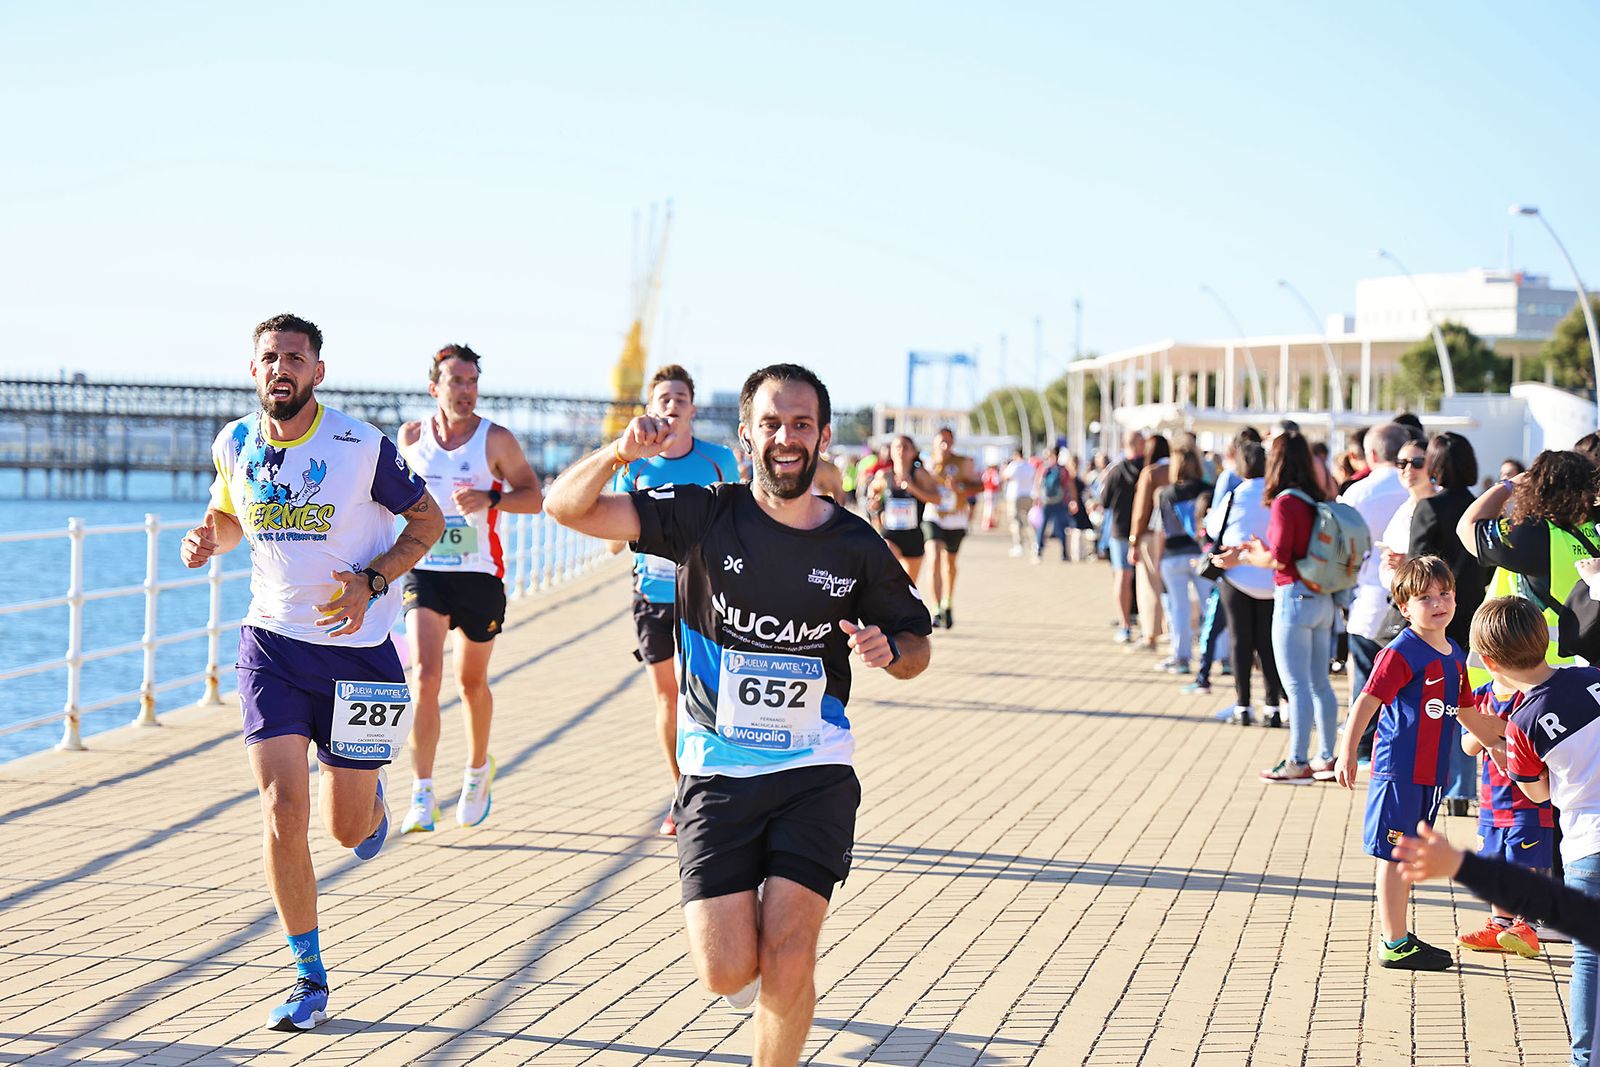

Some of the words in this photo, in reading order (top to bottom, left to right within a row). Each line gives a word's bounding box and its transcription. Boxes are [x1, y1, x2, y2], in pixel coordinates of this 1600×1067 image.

[744, 658, 768, 669] HUELVA
[771, 661, 802, 671] AVATEL
[739, 678, 808, 708] 652
[348, 703, 406, 727] 287
[735, 728, 786, 743] Wayalia
[1538, 712, 1567, 740] R
[346, 744, 385, 754] Wayalia
